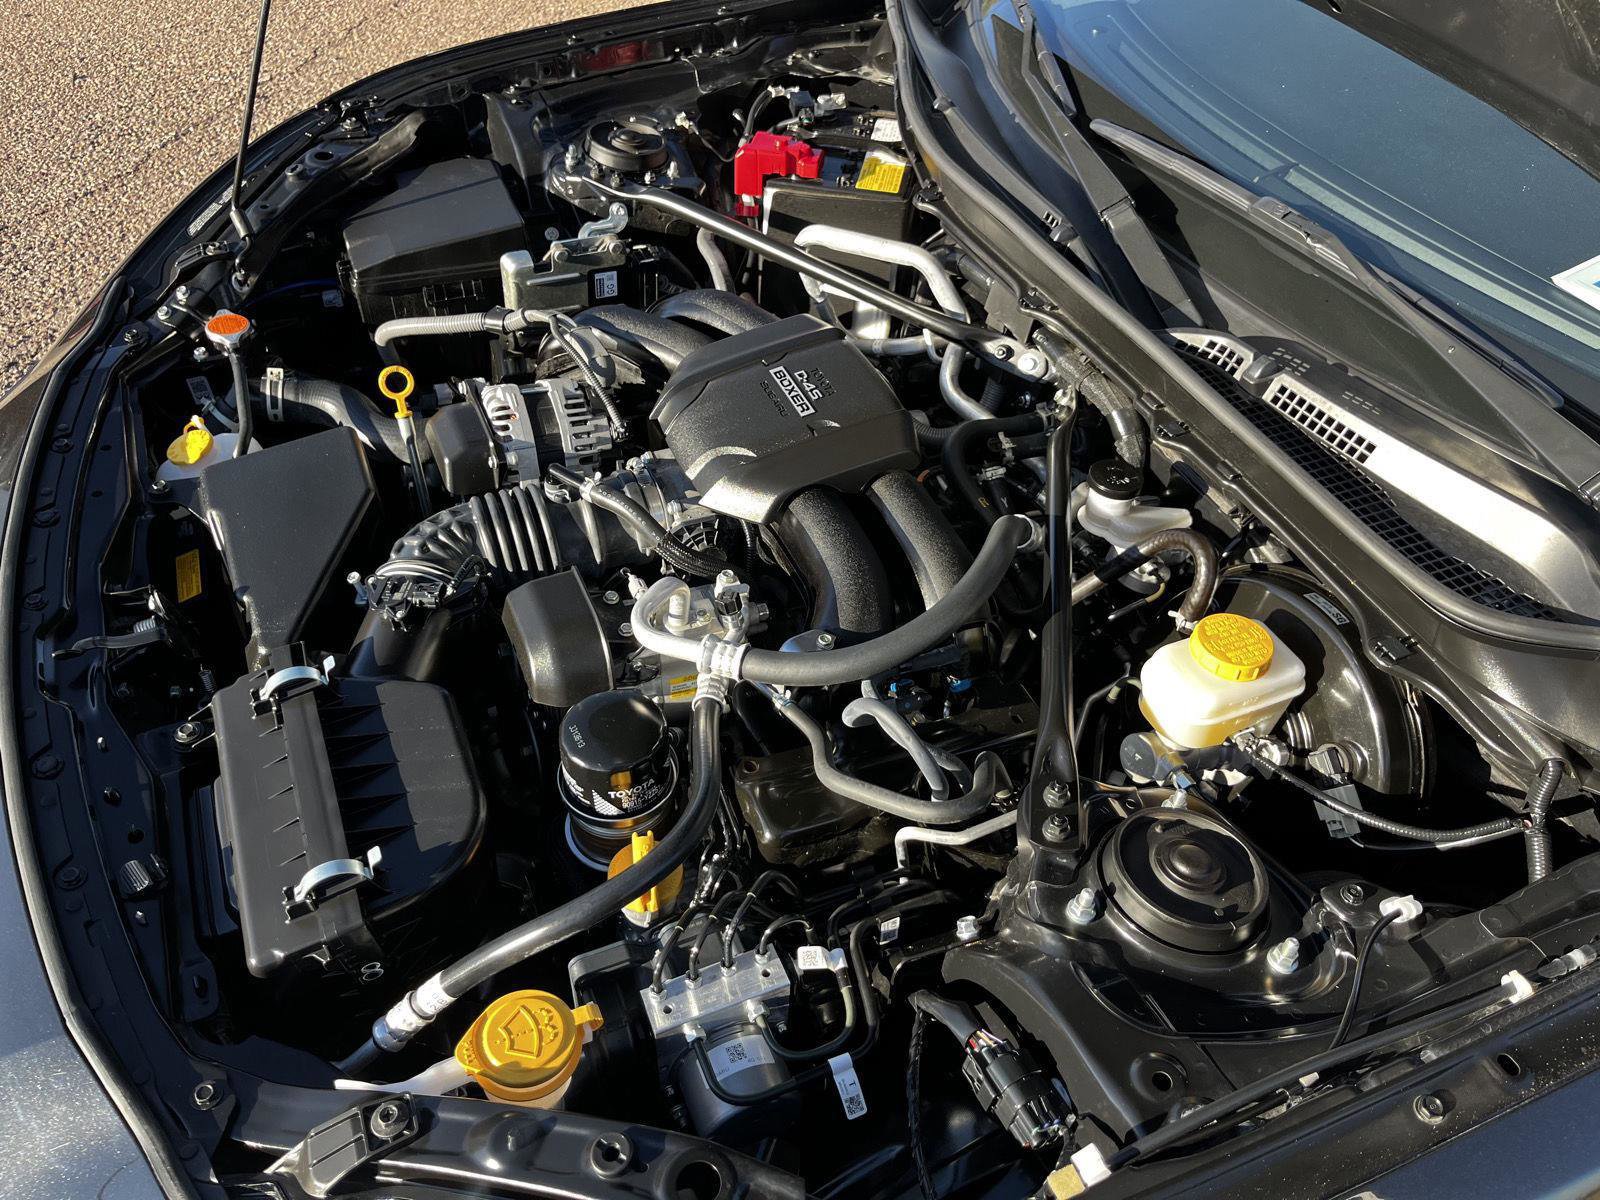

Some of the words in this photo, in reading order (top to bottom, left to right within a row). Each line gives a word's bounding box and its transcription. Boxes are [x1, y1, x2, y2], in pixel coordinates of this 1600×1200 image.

[774, 370, 811, 413] BOXER
[811, 367, 836, 396] TOYOTA
[760, 381, 789, 417] SUBARU
[608, 778, 655, 799] TOYOTA
